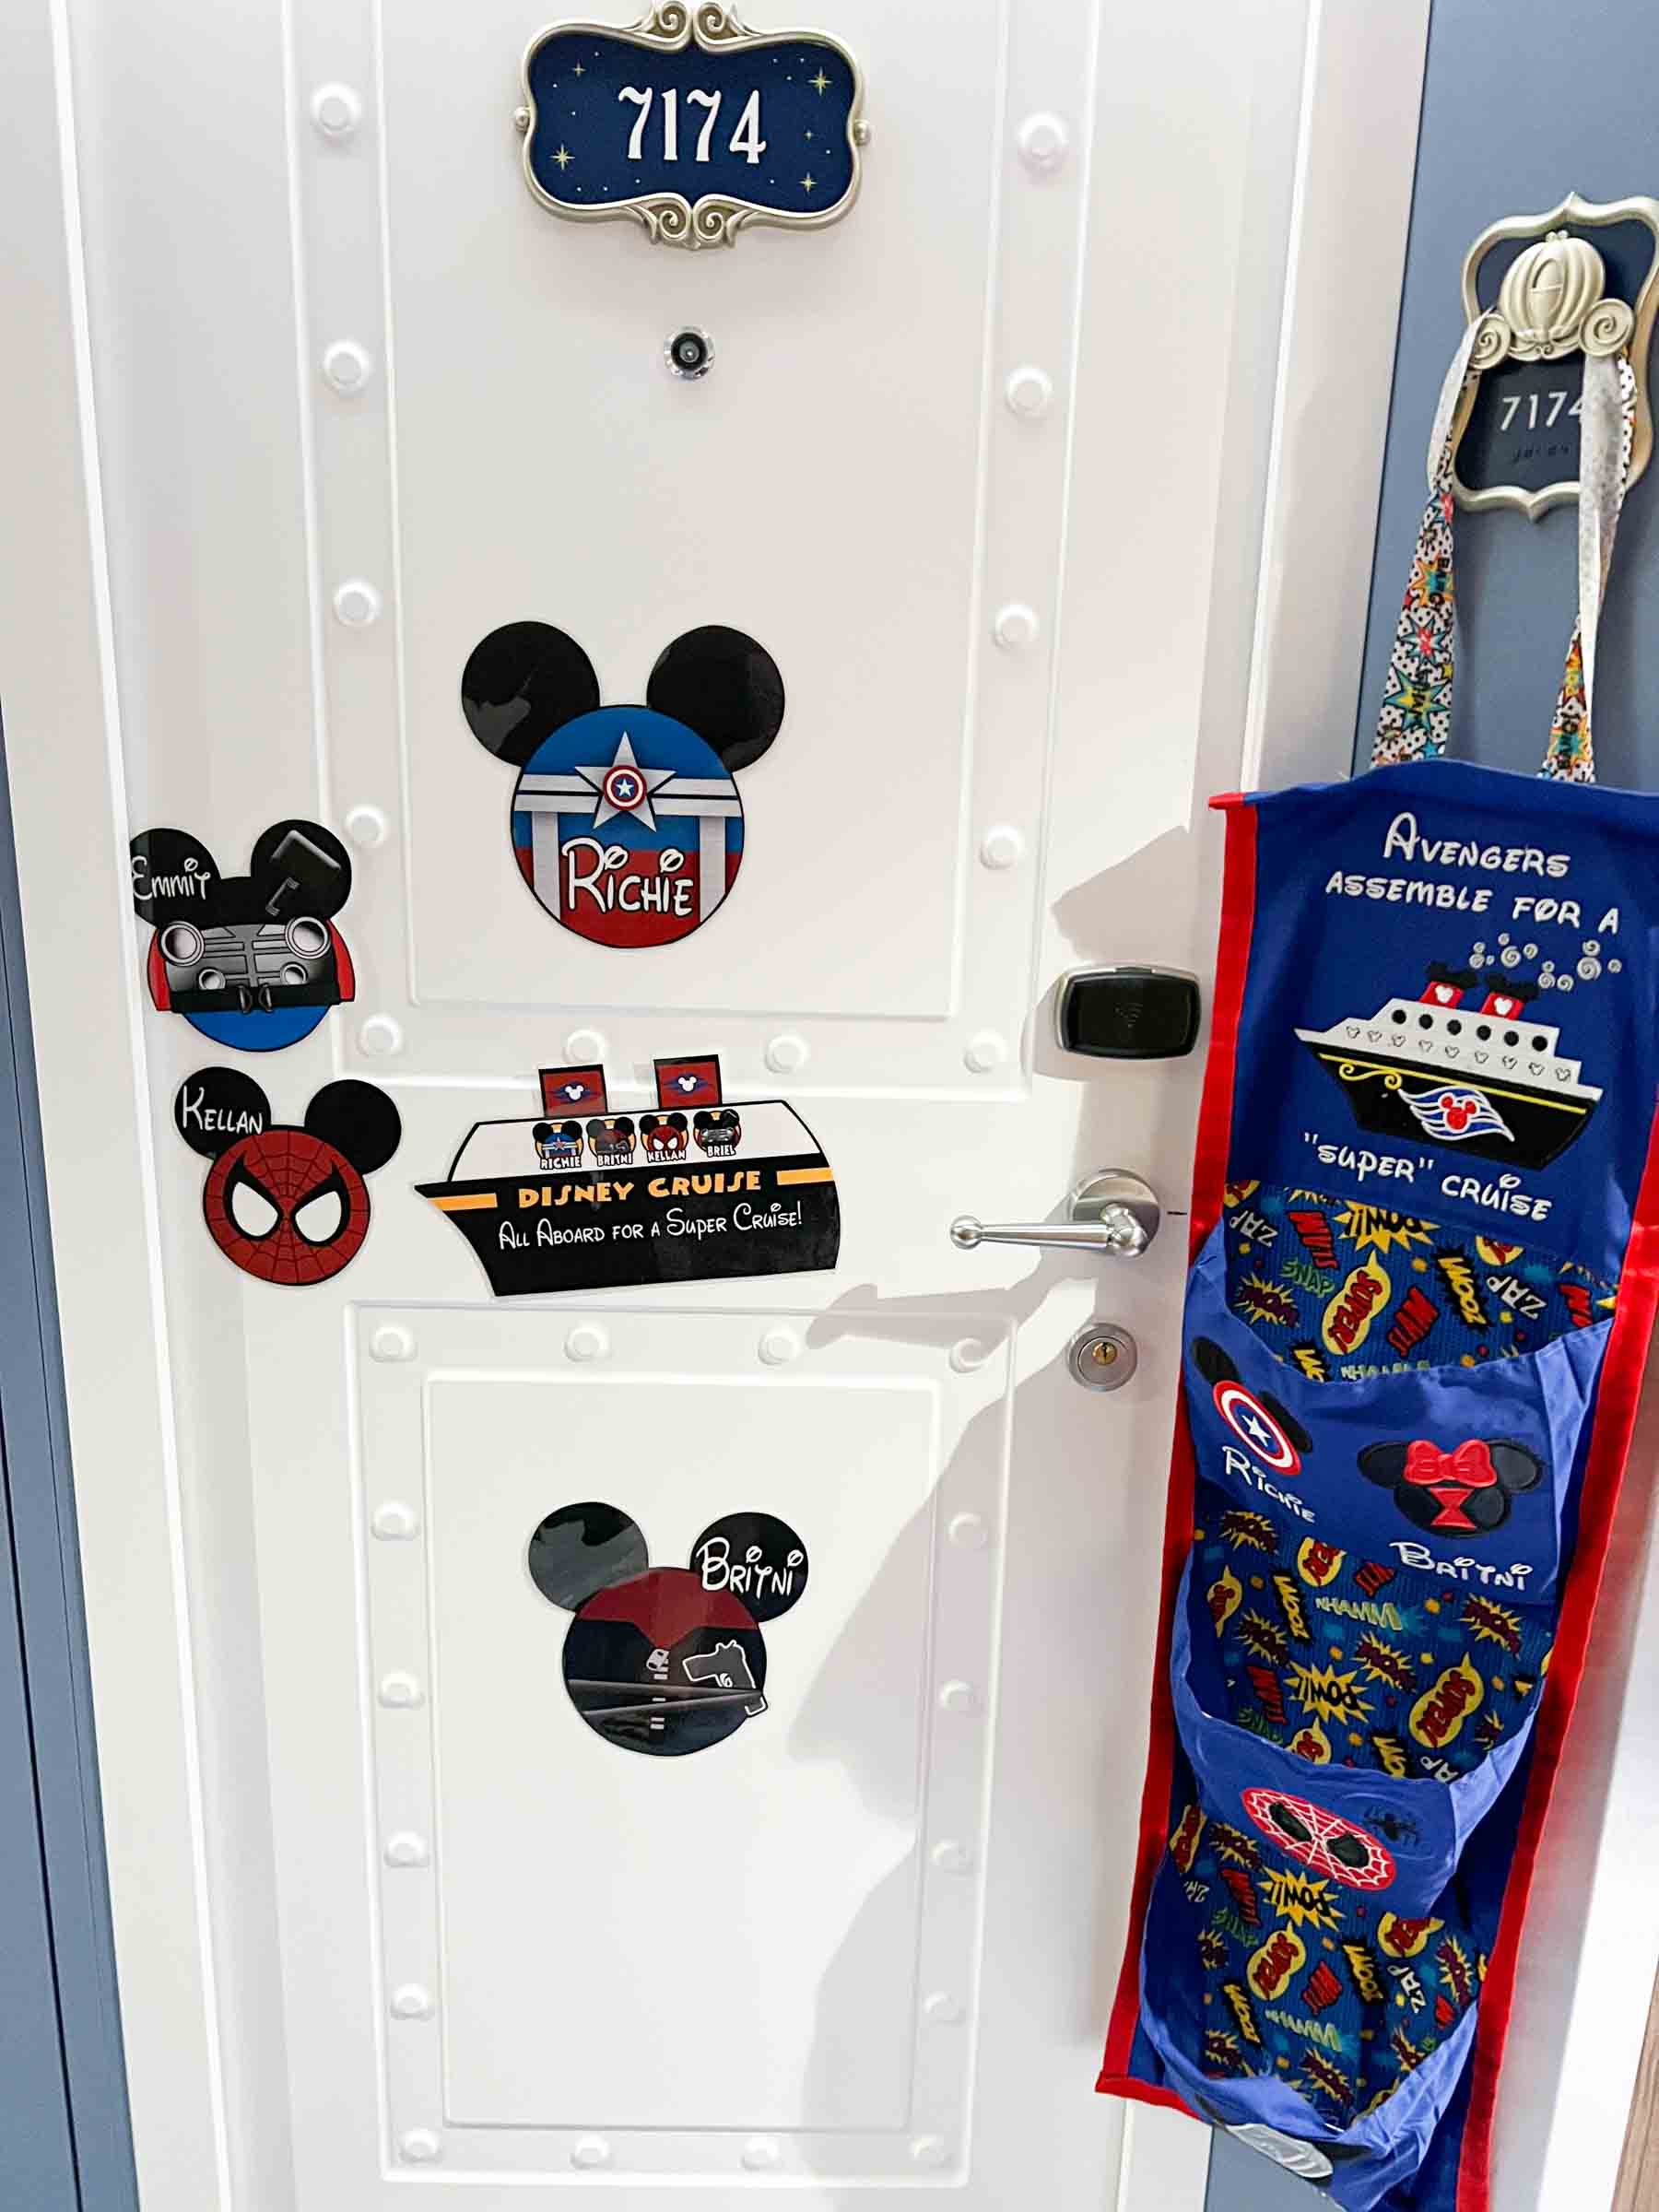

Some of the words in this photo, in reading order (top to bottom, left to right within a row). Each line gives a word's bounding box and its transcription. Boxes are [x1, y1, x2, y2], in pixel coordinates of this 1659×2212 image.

[618, 86, 767, 164] 7174
[1598, 908, 1620, 935] A
[539, 1155, 582, 1171] RICHIE
[596, 1151, 634, 1167] BRITNI
[646, 1149, 687, 1163] KELLAN
[518, 1182, 635, 1209] DISNEY
[648, 1170, 762, 1198] CRUISE
[1229, 1209, 1278, 1248] ZAP
[1280, 1257, 1335, 1298] SNAP
[1437, 1256, 1488, 1324] ZOOM
[1486, 1275, 1547, 1320] ZAP
[1387, 1965, 1427, 2014] ZAP
